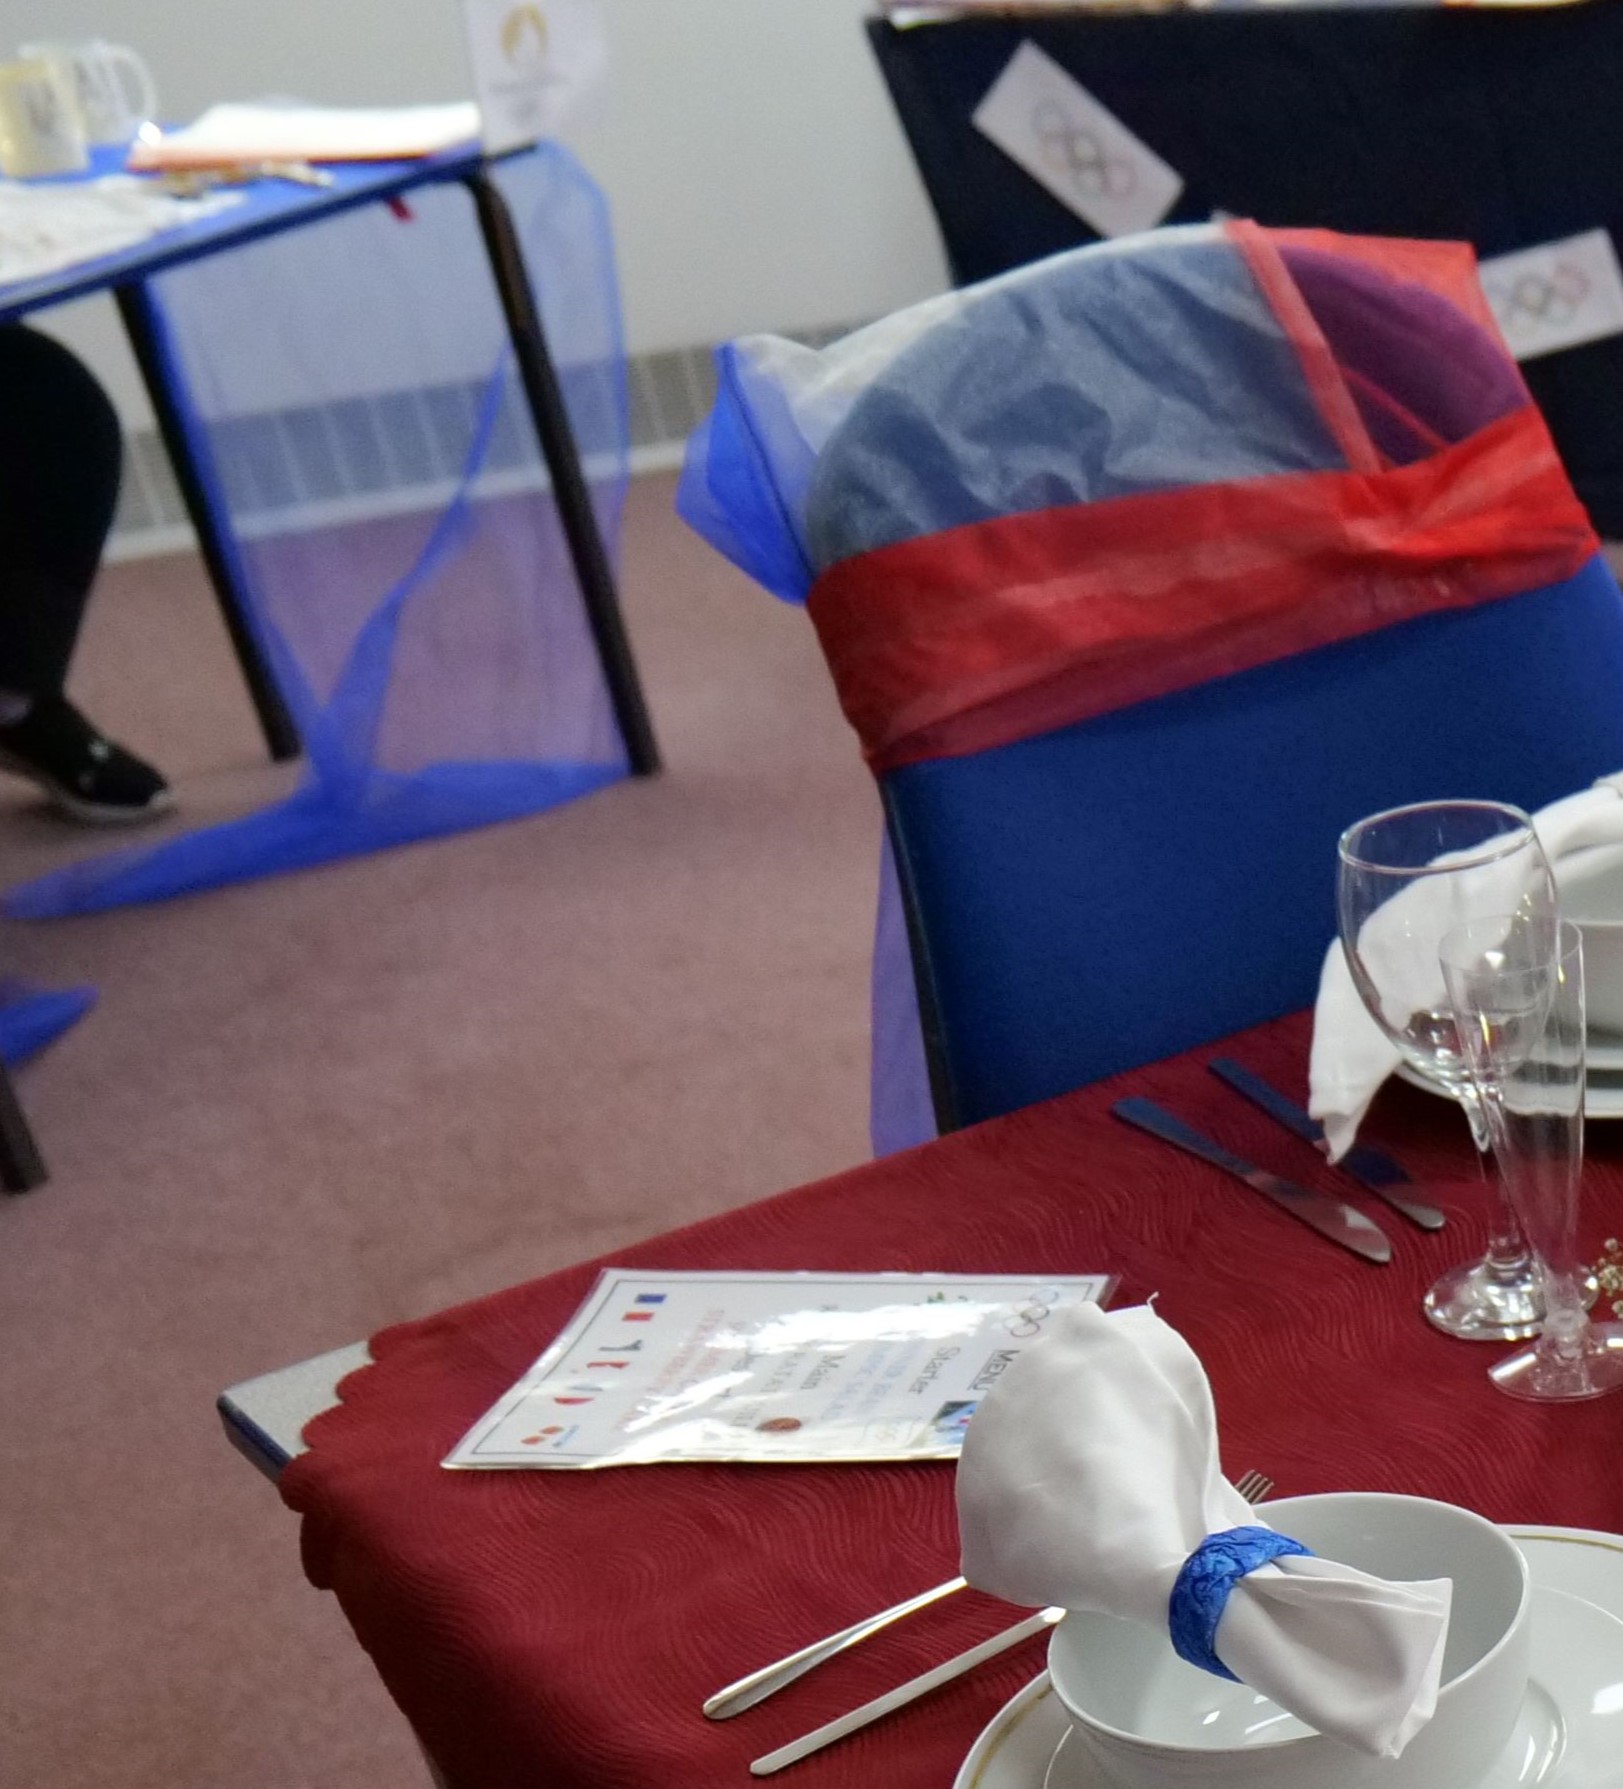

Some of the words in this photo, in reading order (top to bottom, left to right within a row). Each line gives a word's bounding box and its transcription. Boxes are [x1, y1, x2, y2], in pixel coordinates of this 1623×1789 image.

[800, 1354, 846, 1390] Main
[909, 1346, 961, 1394] Starter
[971, 1350, 1020, 1392] MENU
